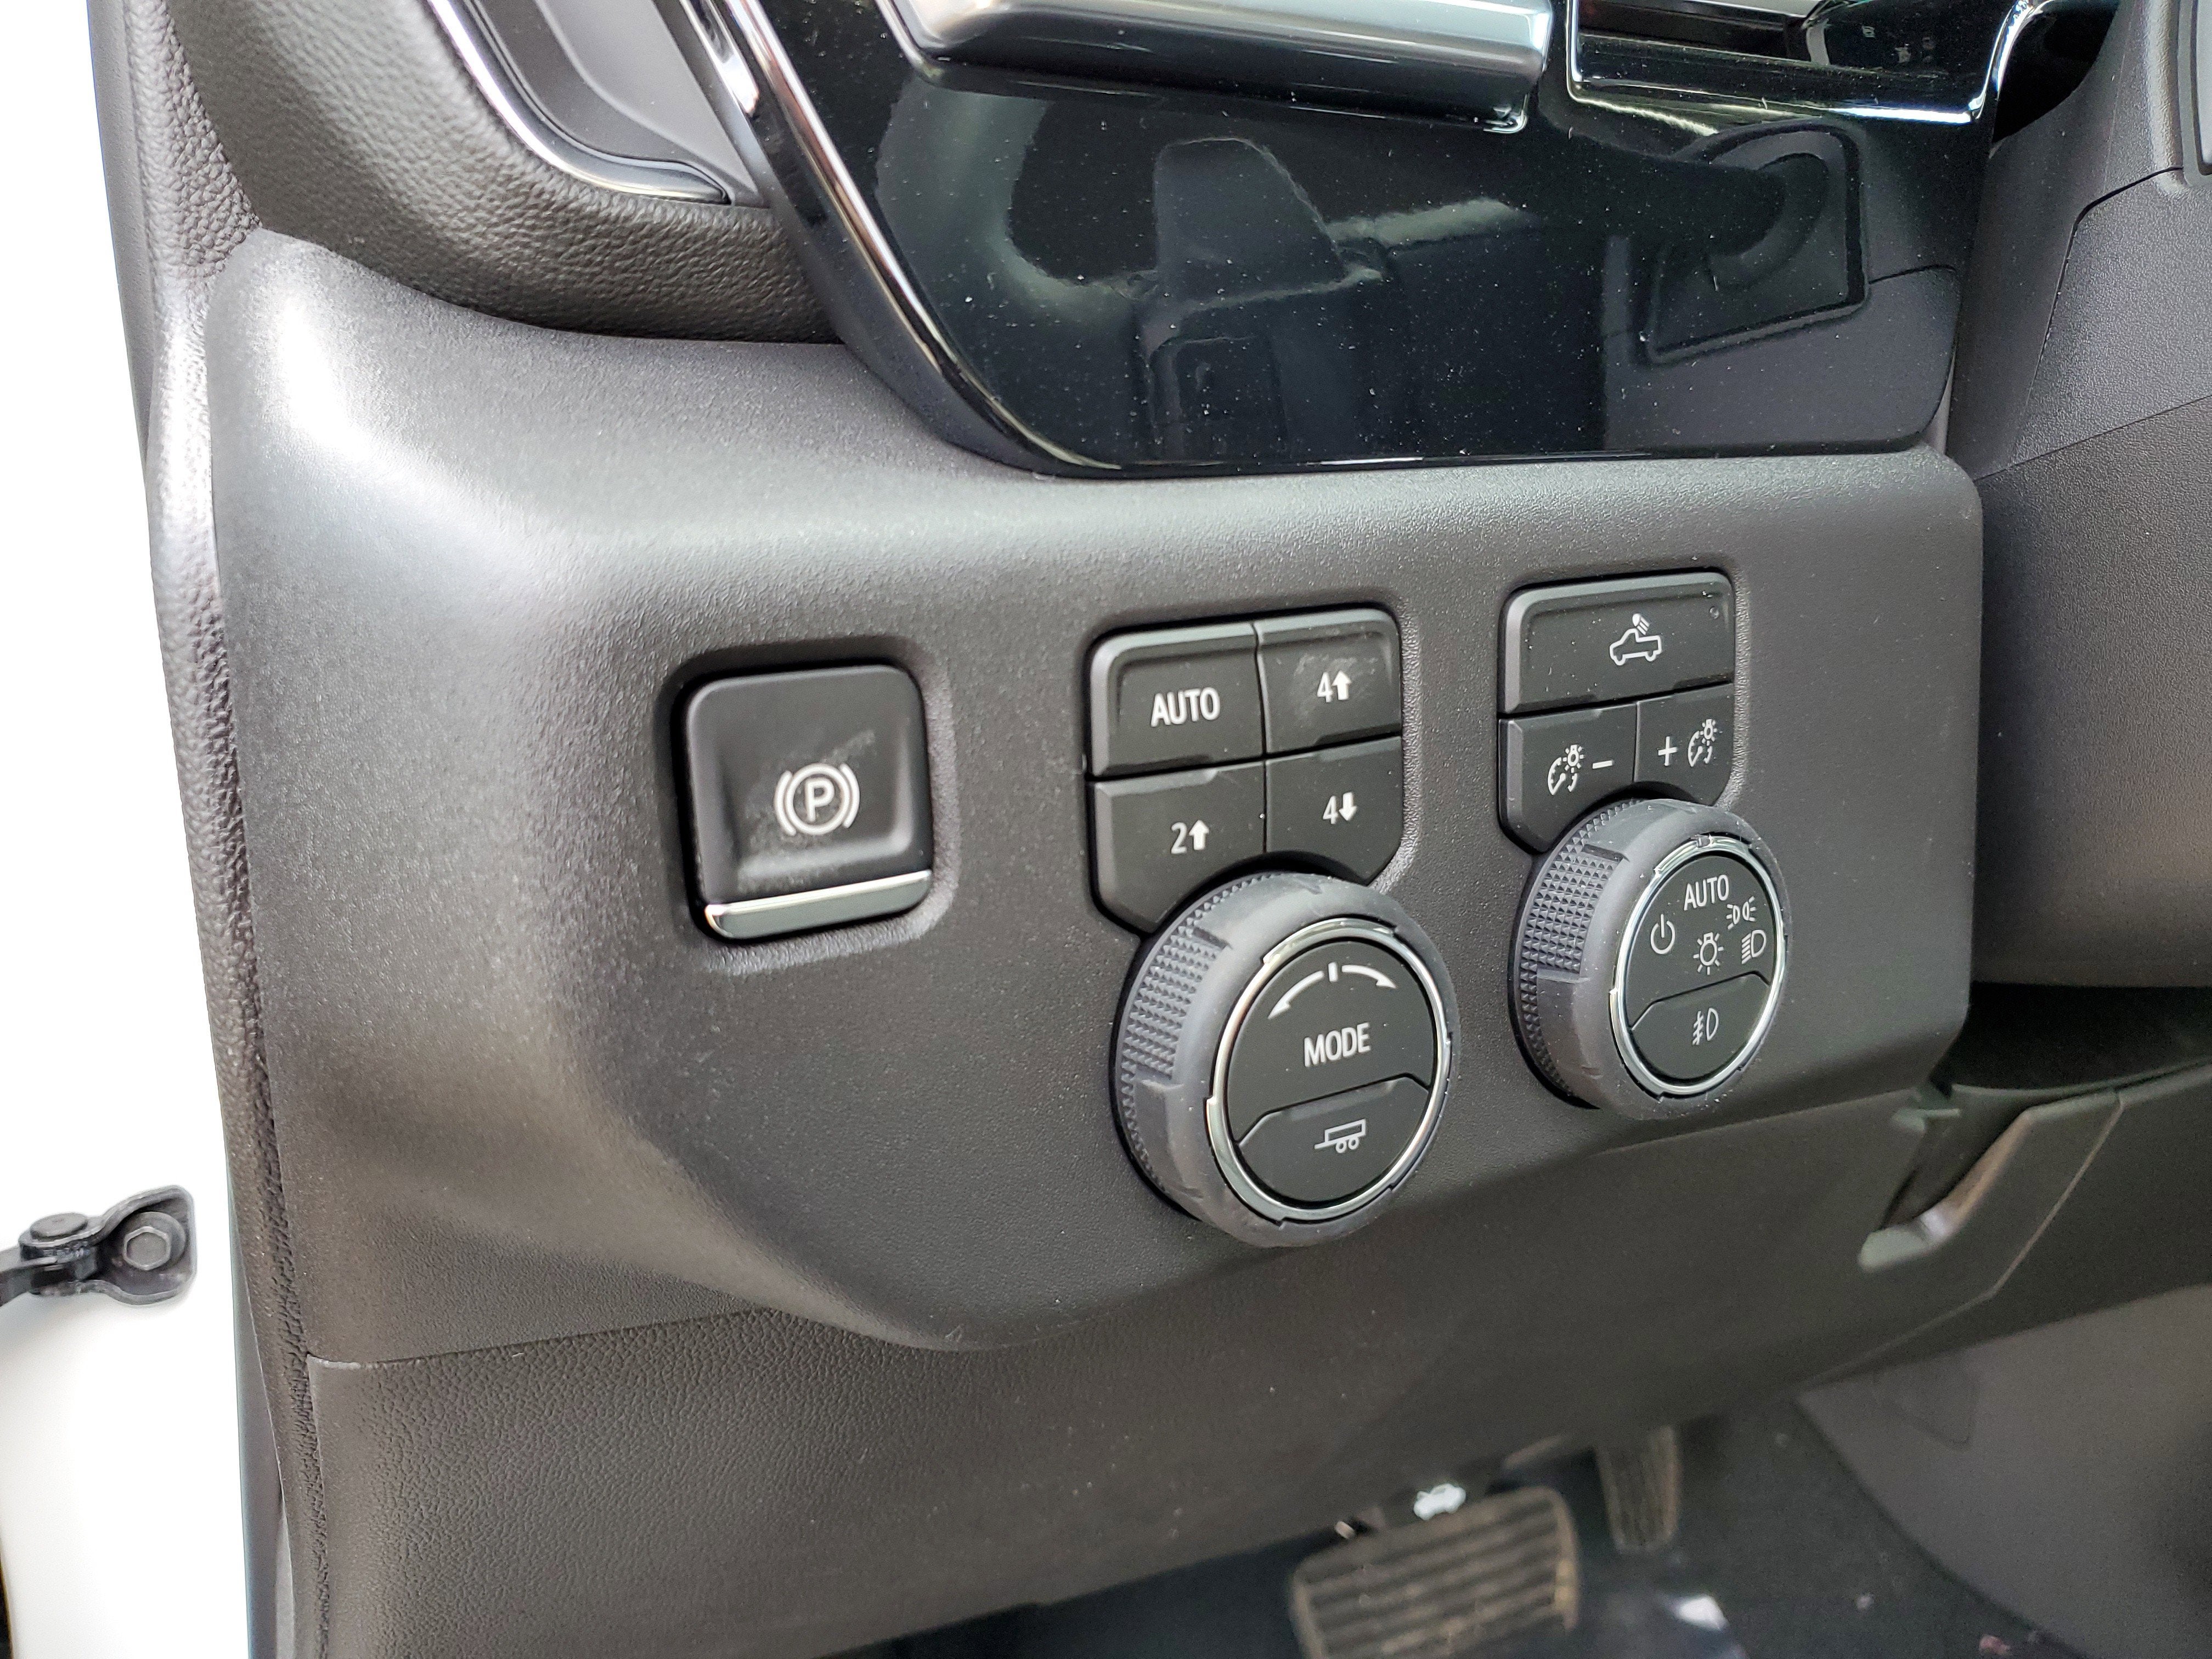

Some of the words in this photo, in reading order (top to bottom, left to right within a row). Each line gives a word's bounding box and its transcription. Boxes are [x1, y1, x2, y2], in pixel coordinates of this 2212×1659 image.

[1317, 672, 1333, 703] 4
[1150, 687, 1221, 727] AUTO
[805, 777, 836, 822] P
[1323, 795, 1338, 824] 4
[1171, 822, 1187, 855] 2
[1684, 874, 1730, 911] AUTO
[1304, 1022, 1371, 1068] MODE
